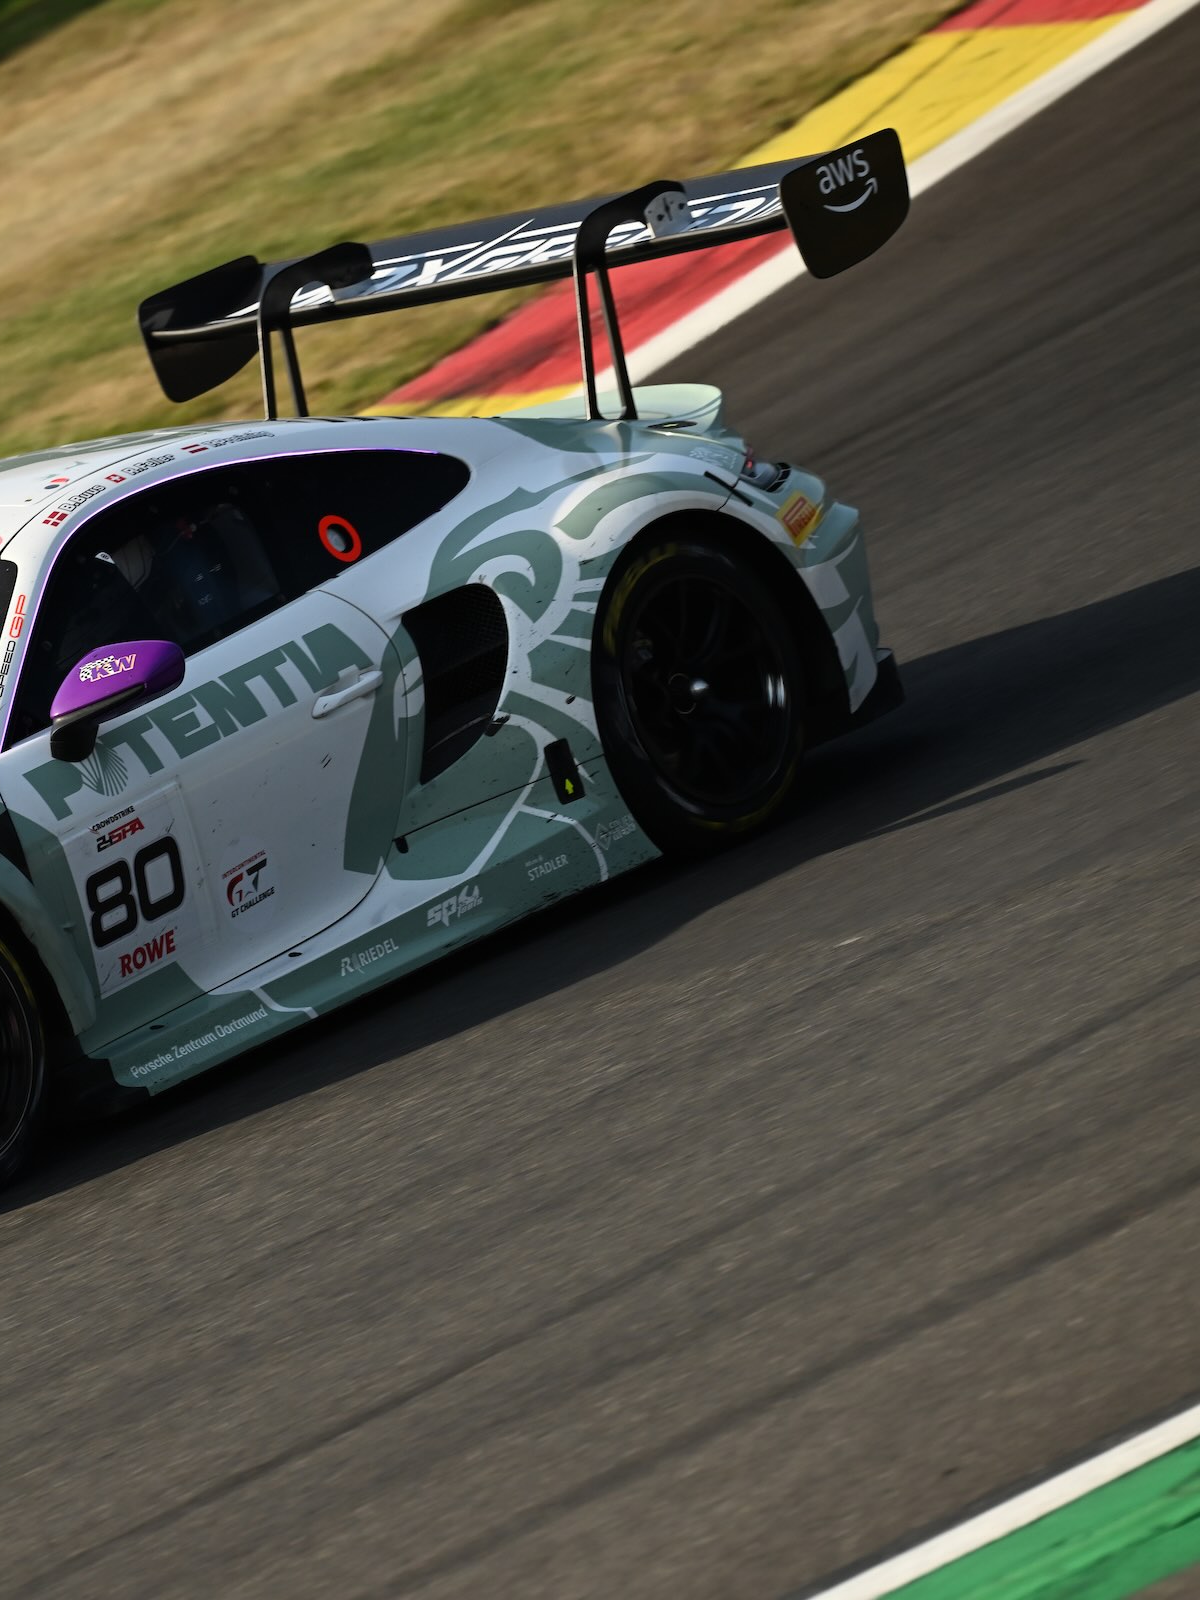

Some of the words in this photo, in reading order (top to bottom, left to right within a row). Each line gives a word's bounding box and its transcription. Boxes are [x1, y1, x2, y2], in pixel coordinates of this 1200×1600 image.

[816, 148, 870, 195] aws
[9, 594, 27, 639] GP
[90, 654, 137, 682] KW
[91, 805, 136, 831] CROWDSTRIKE
[528, 854, 569, 881] STADLER
[86, 835, 186, 949] 80
[231, 908, 240, 918] GT
[240, 887, 275, 913] CHALLENGE
[118, 929, 176, 978] ROWE
[358, 938, 400, 967] RIEDEL
[130, 1054, 175, 1079] Porsche
[171, 1031, 218, 1059] Zentrum
[214, 1004, 269, 1038] Dortmund
